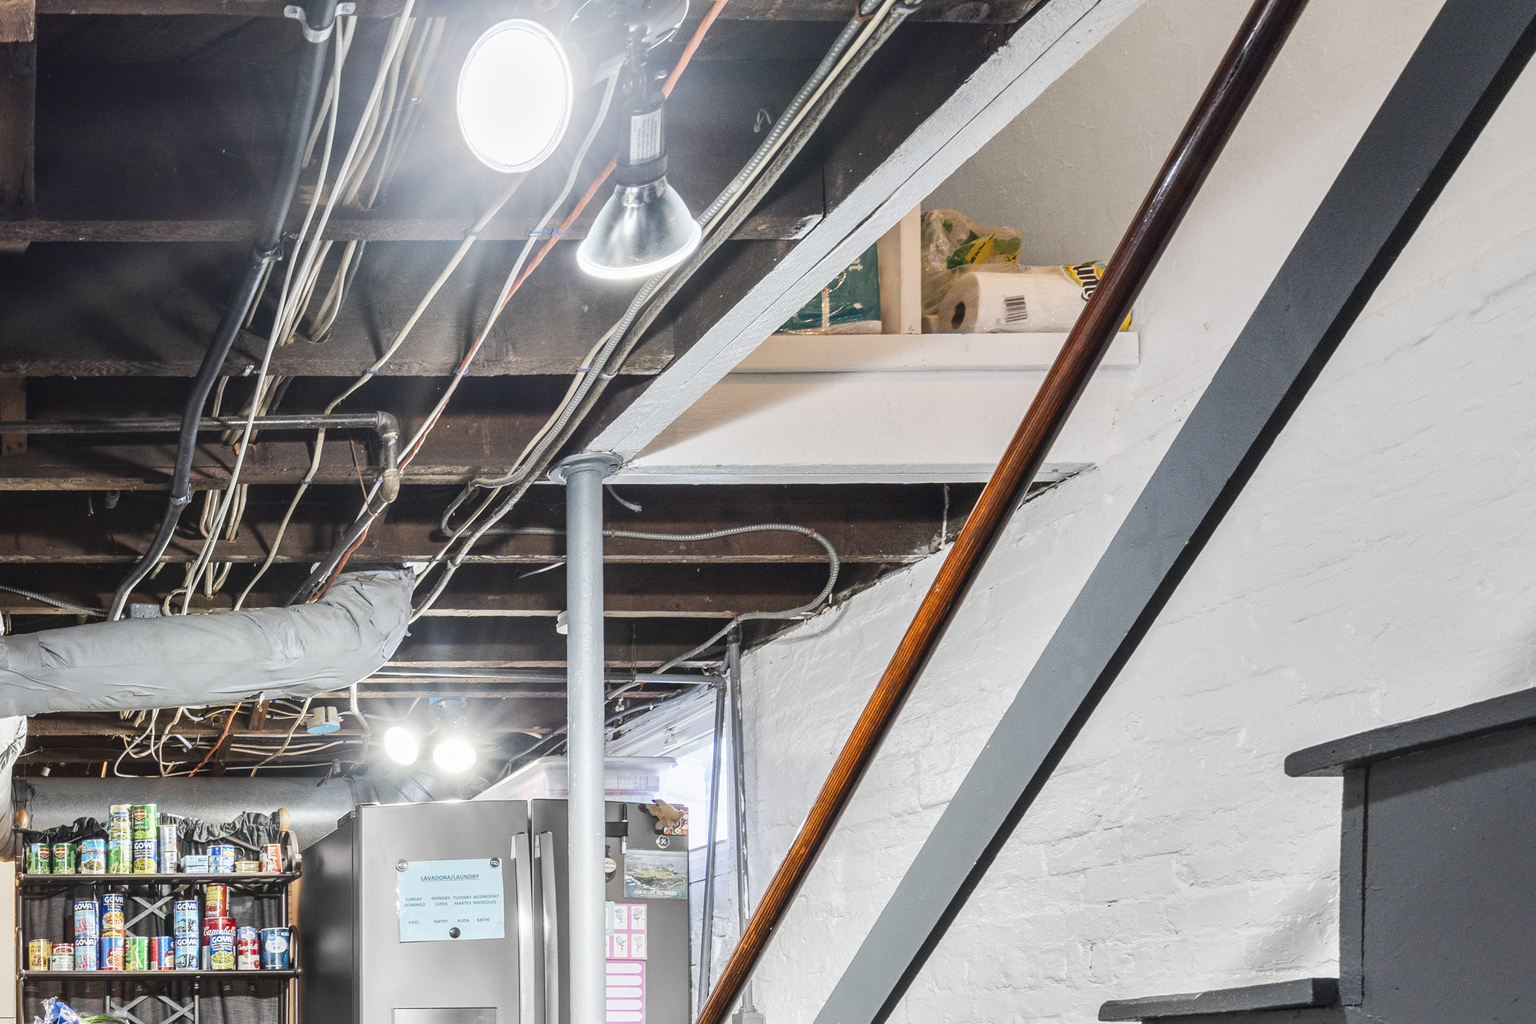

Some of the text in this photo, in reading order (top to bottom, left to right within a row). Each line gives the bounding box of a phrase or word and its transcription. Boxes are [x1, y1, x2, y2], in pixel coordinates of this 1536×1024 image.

[134, 841, 154, 849] GOYA
[420, 874, 480, 882] LAVADORA/LAUNDRY
[177, 938, 197, 946] GOYA
